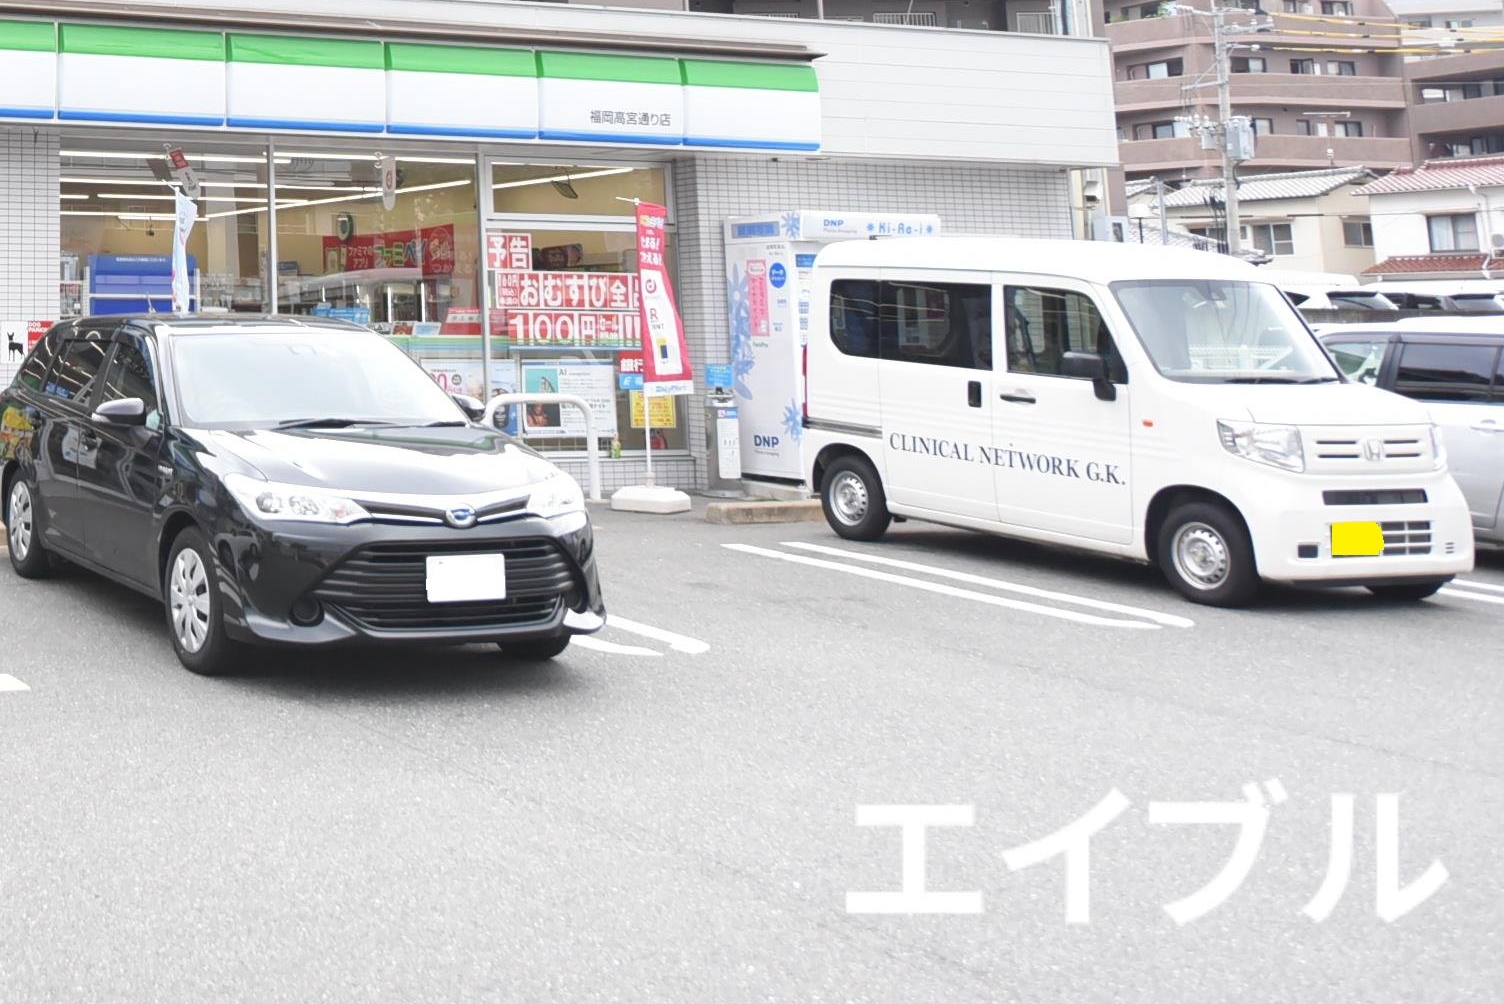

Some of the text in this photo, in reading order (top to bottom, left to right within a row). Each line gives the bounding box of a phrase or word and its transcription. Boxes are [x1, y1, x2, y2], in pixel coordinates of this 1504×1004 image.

[590, 109, 671, 127] 福岡高宮通り店
[823, 219, 844, 227] DNP
[489, 236, 529, 268] 予告
[520, 273, 640, 308] おむすび全
[754, 435, 780, 448] DNP
[889, 432, 1126, 486] CLINICAL NETWORK G.K.
